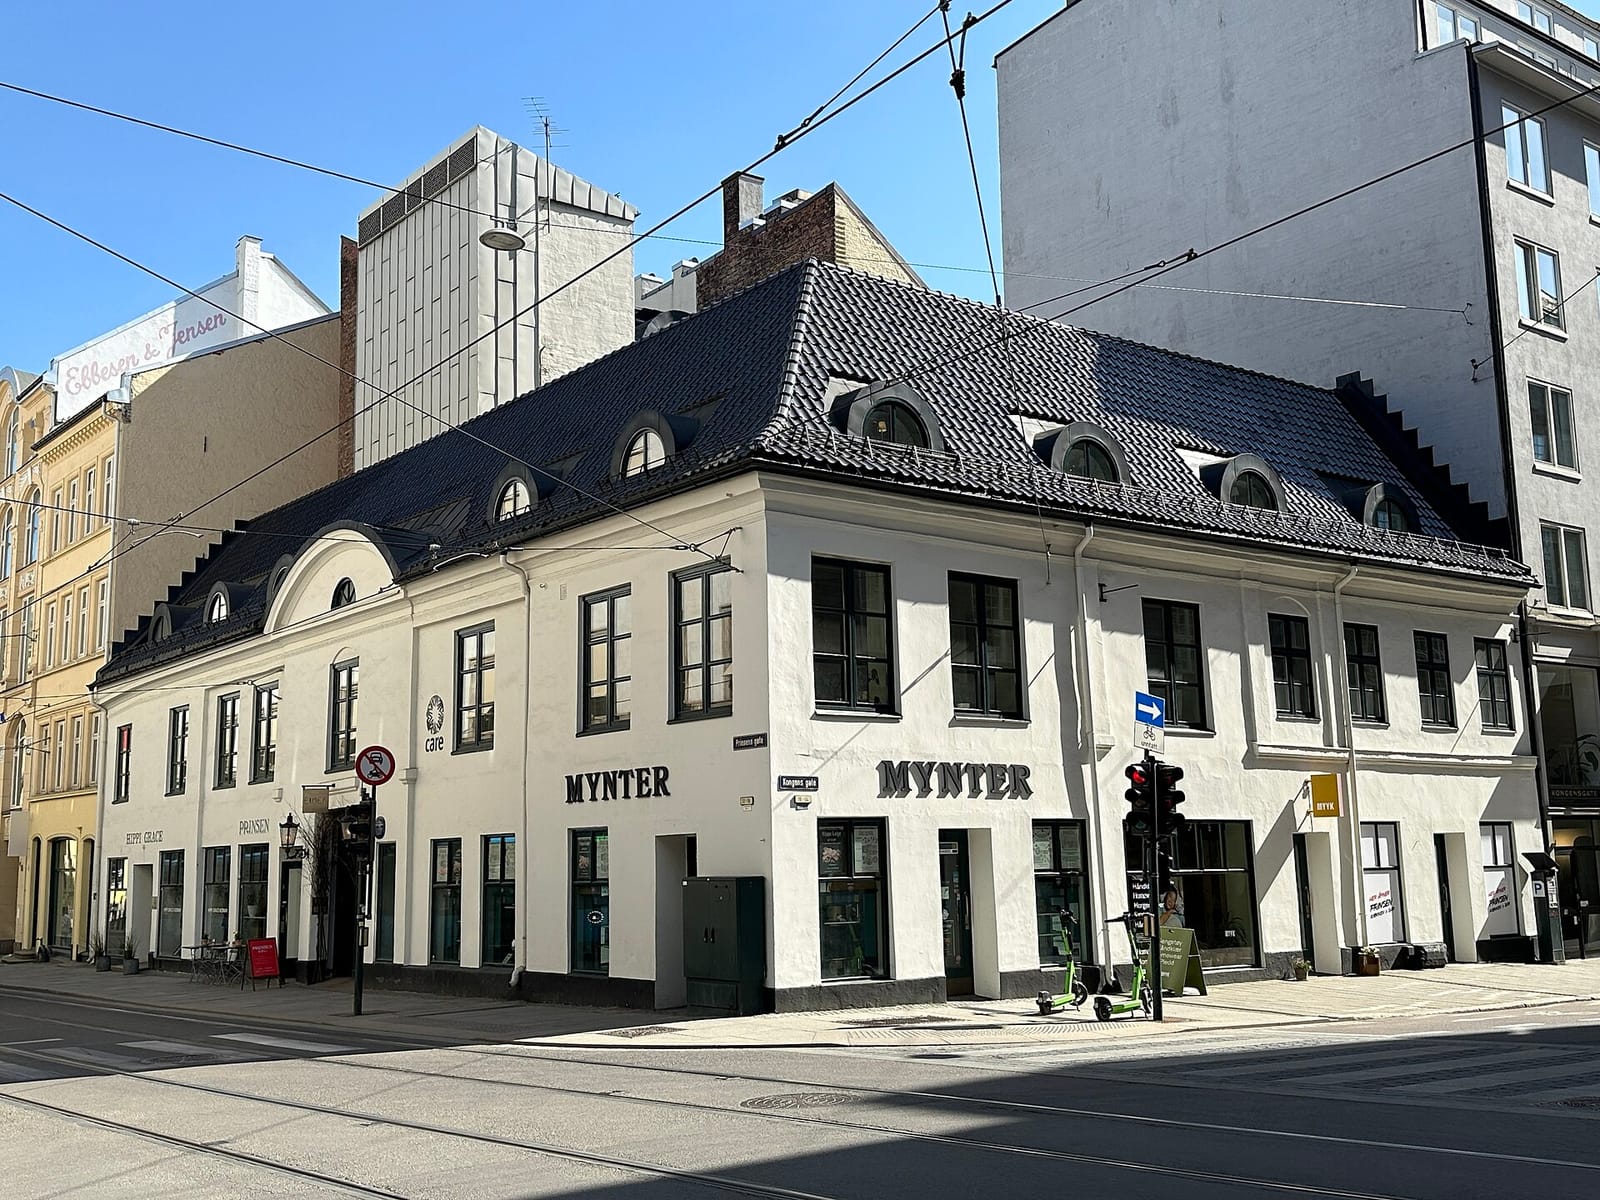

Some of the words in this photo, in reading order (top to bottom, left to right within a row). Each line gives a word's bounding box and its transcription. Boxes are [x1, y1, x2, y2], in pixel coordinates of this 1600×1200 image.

[65, 352, 140, 395] Ebbesen
[144, 343, 160, 361] &
[158, 313, 227, 359] Jensen
[425, 736, 444, 752] care
[564, 766, 671, 804] MYNTER
[875, 760, 1034, 800] MYNTER
[126, 832, 142, 845] HIPPI
[144, 830, 163, 843] GRACE
[239, 818, 270, 835] PRINSEN
